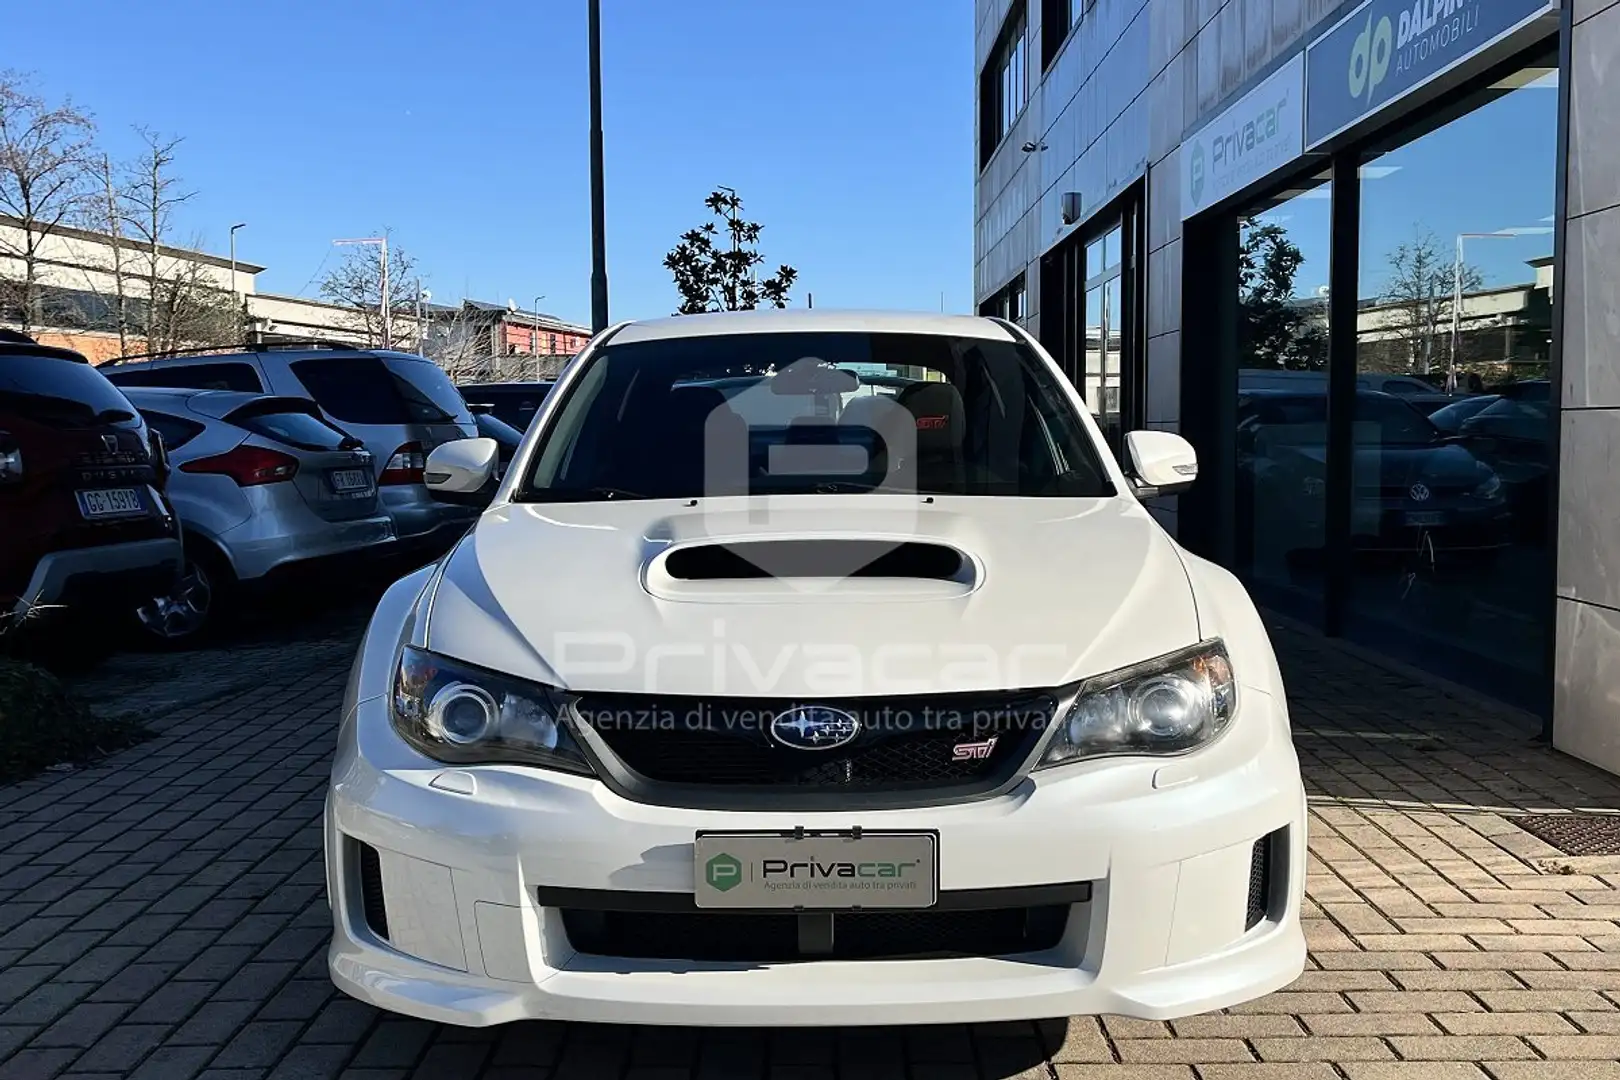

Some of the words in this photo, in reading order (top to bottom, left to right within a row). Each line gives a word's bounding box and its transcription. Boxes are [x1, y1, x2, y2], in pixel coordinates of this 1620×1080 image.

[1395, 4, 1480, 77] AUTOMOBILI
[1212, 97, 1287, 175] Privacar
[762, 856, 917, 878] Privacar
[764, 880, 801, 891] Agenzia
[802, 880, 813, 889] di
[814, 880, 847, 889] vendita
[849, 881, 871, 889] auto
[873, 880, 885, 889] tra
[887, 880, 916, 891] privati
